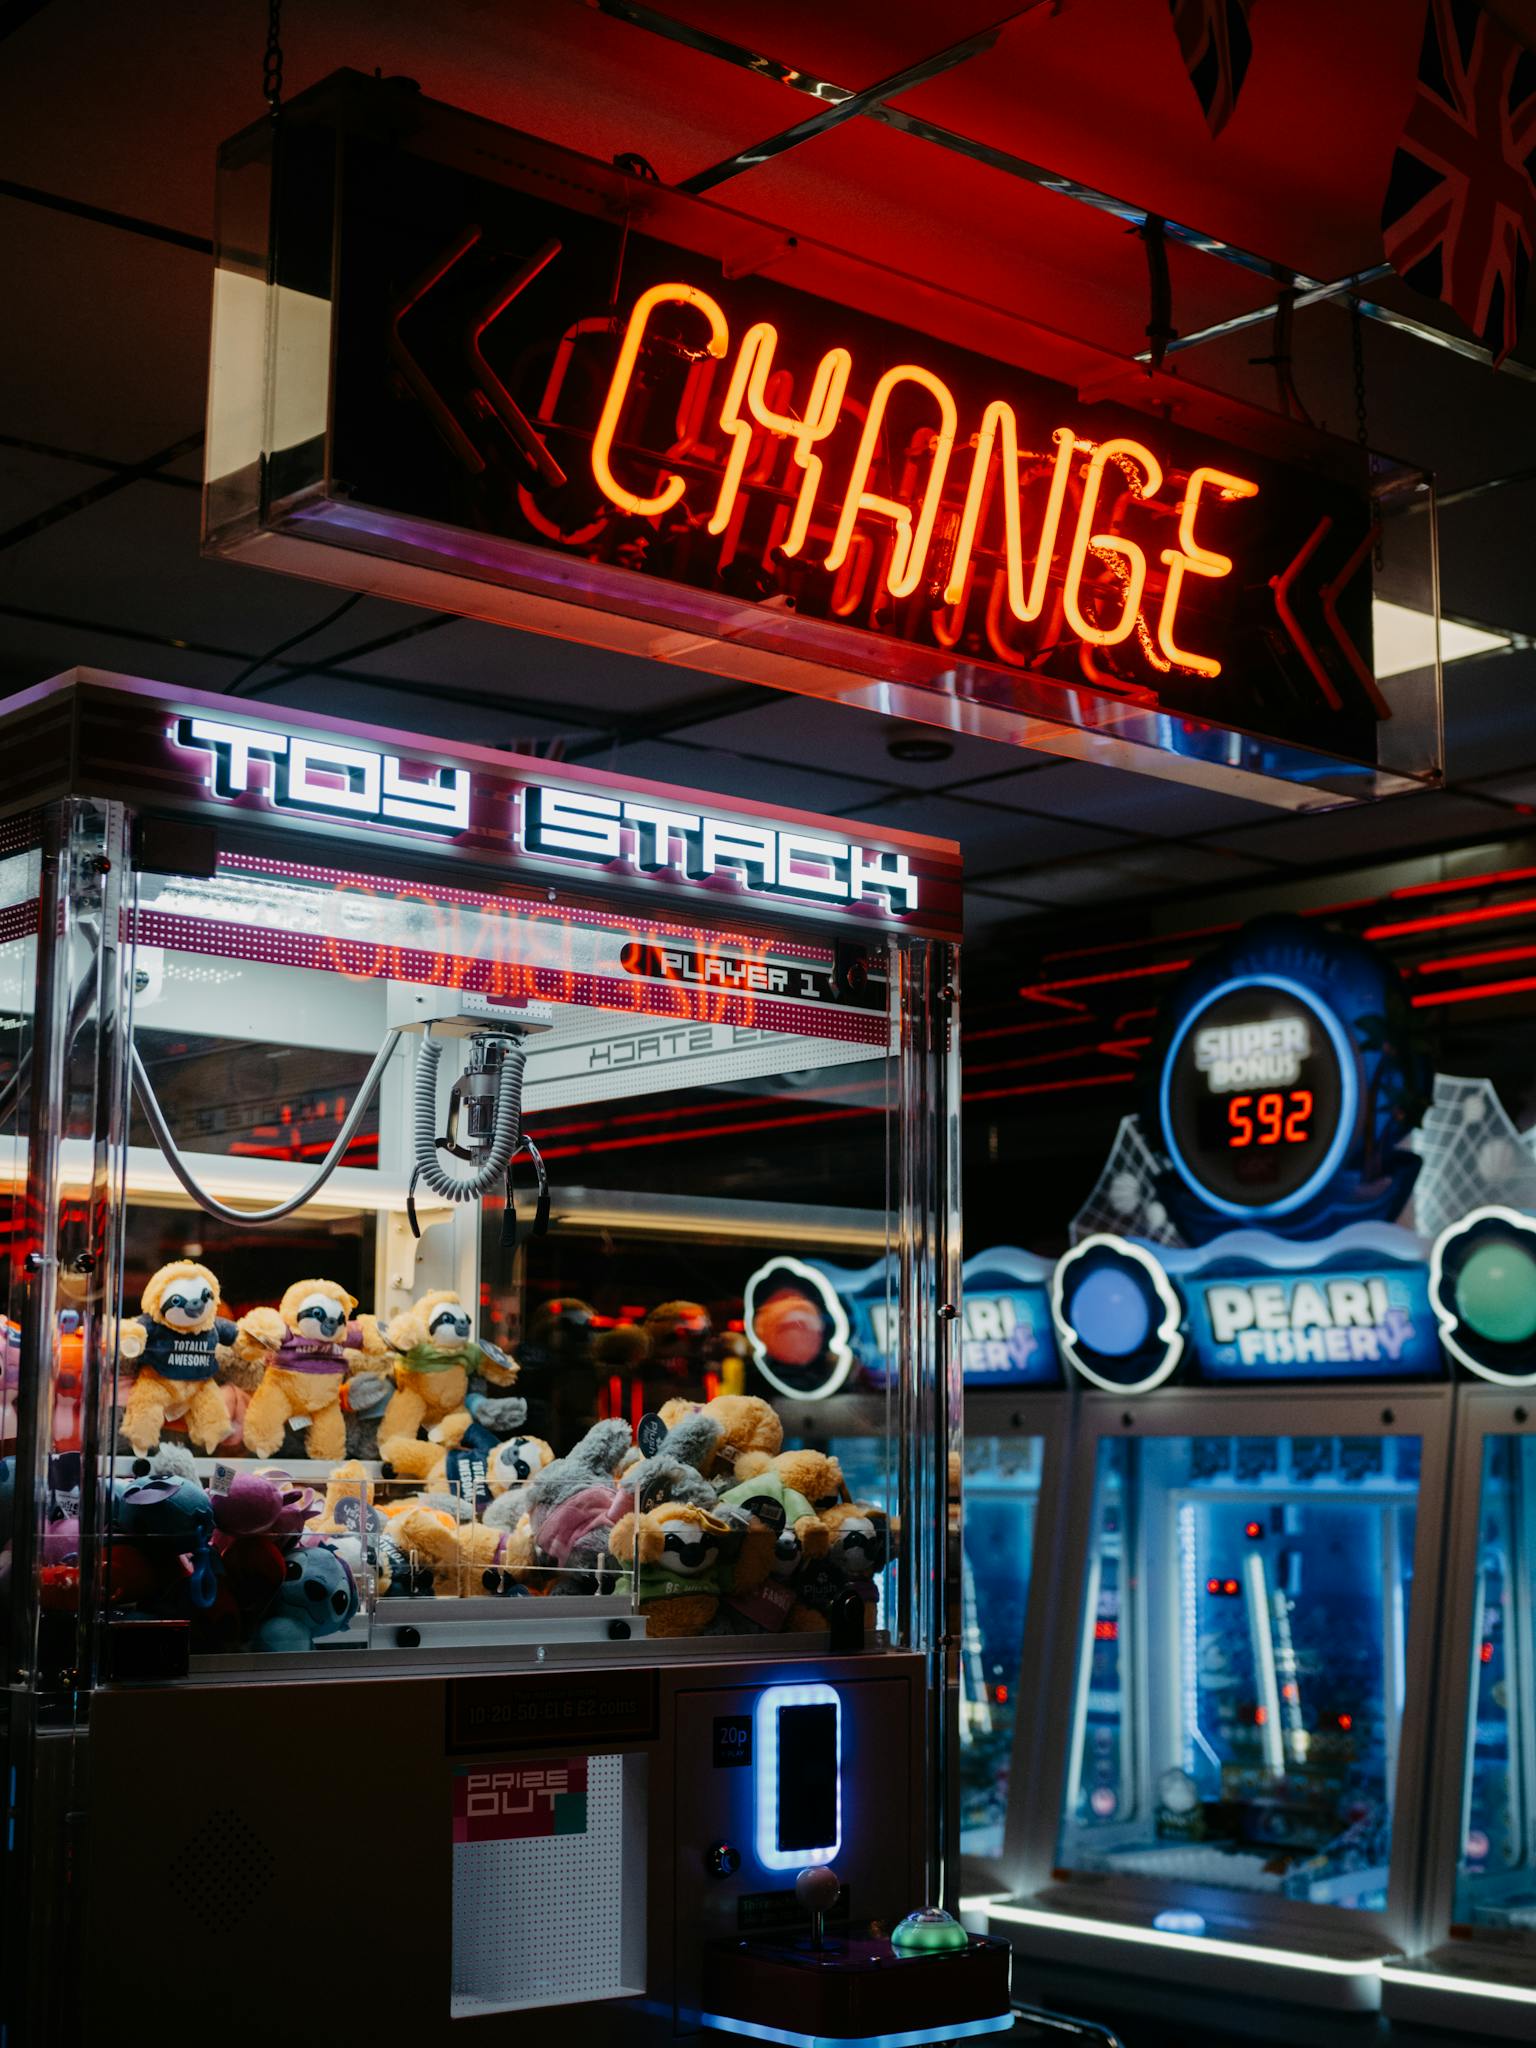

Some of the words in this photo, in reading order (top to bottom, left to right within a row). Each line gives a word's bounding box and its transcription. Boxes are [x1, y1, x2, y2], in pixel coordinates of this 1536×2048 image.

[591, 281, 1260, 678] CHANGE
[182, 718, 471, 832] TOY
[532, 786, 919, 912] STACK
[661, 951, 789, 992] PLAYER
[800, 972, 821, 998] 1
[1228, 1090, 1313, 1147] 592
[174, 1340, 208, 1353] TOTALLY
[1238, 1306, 1413, 1365] FISHERY
[719, 1726, 748, 1748] 20p
[467, 1768, 569, 1793] PRIZE
[467, 1787, 569, 1817] OUT
